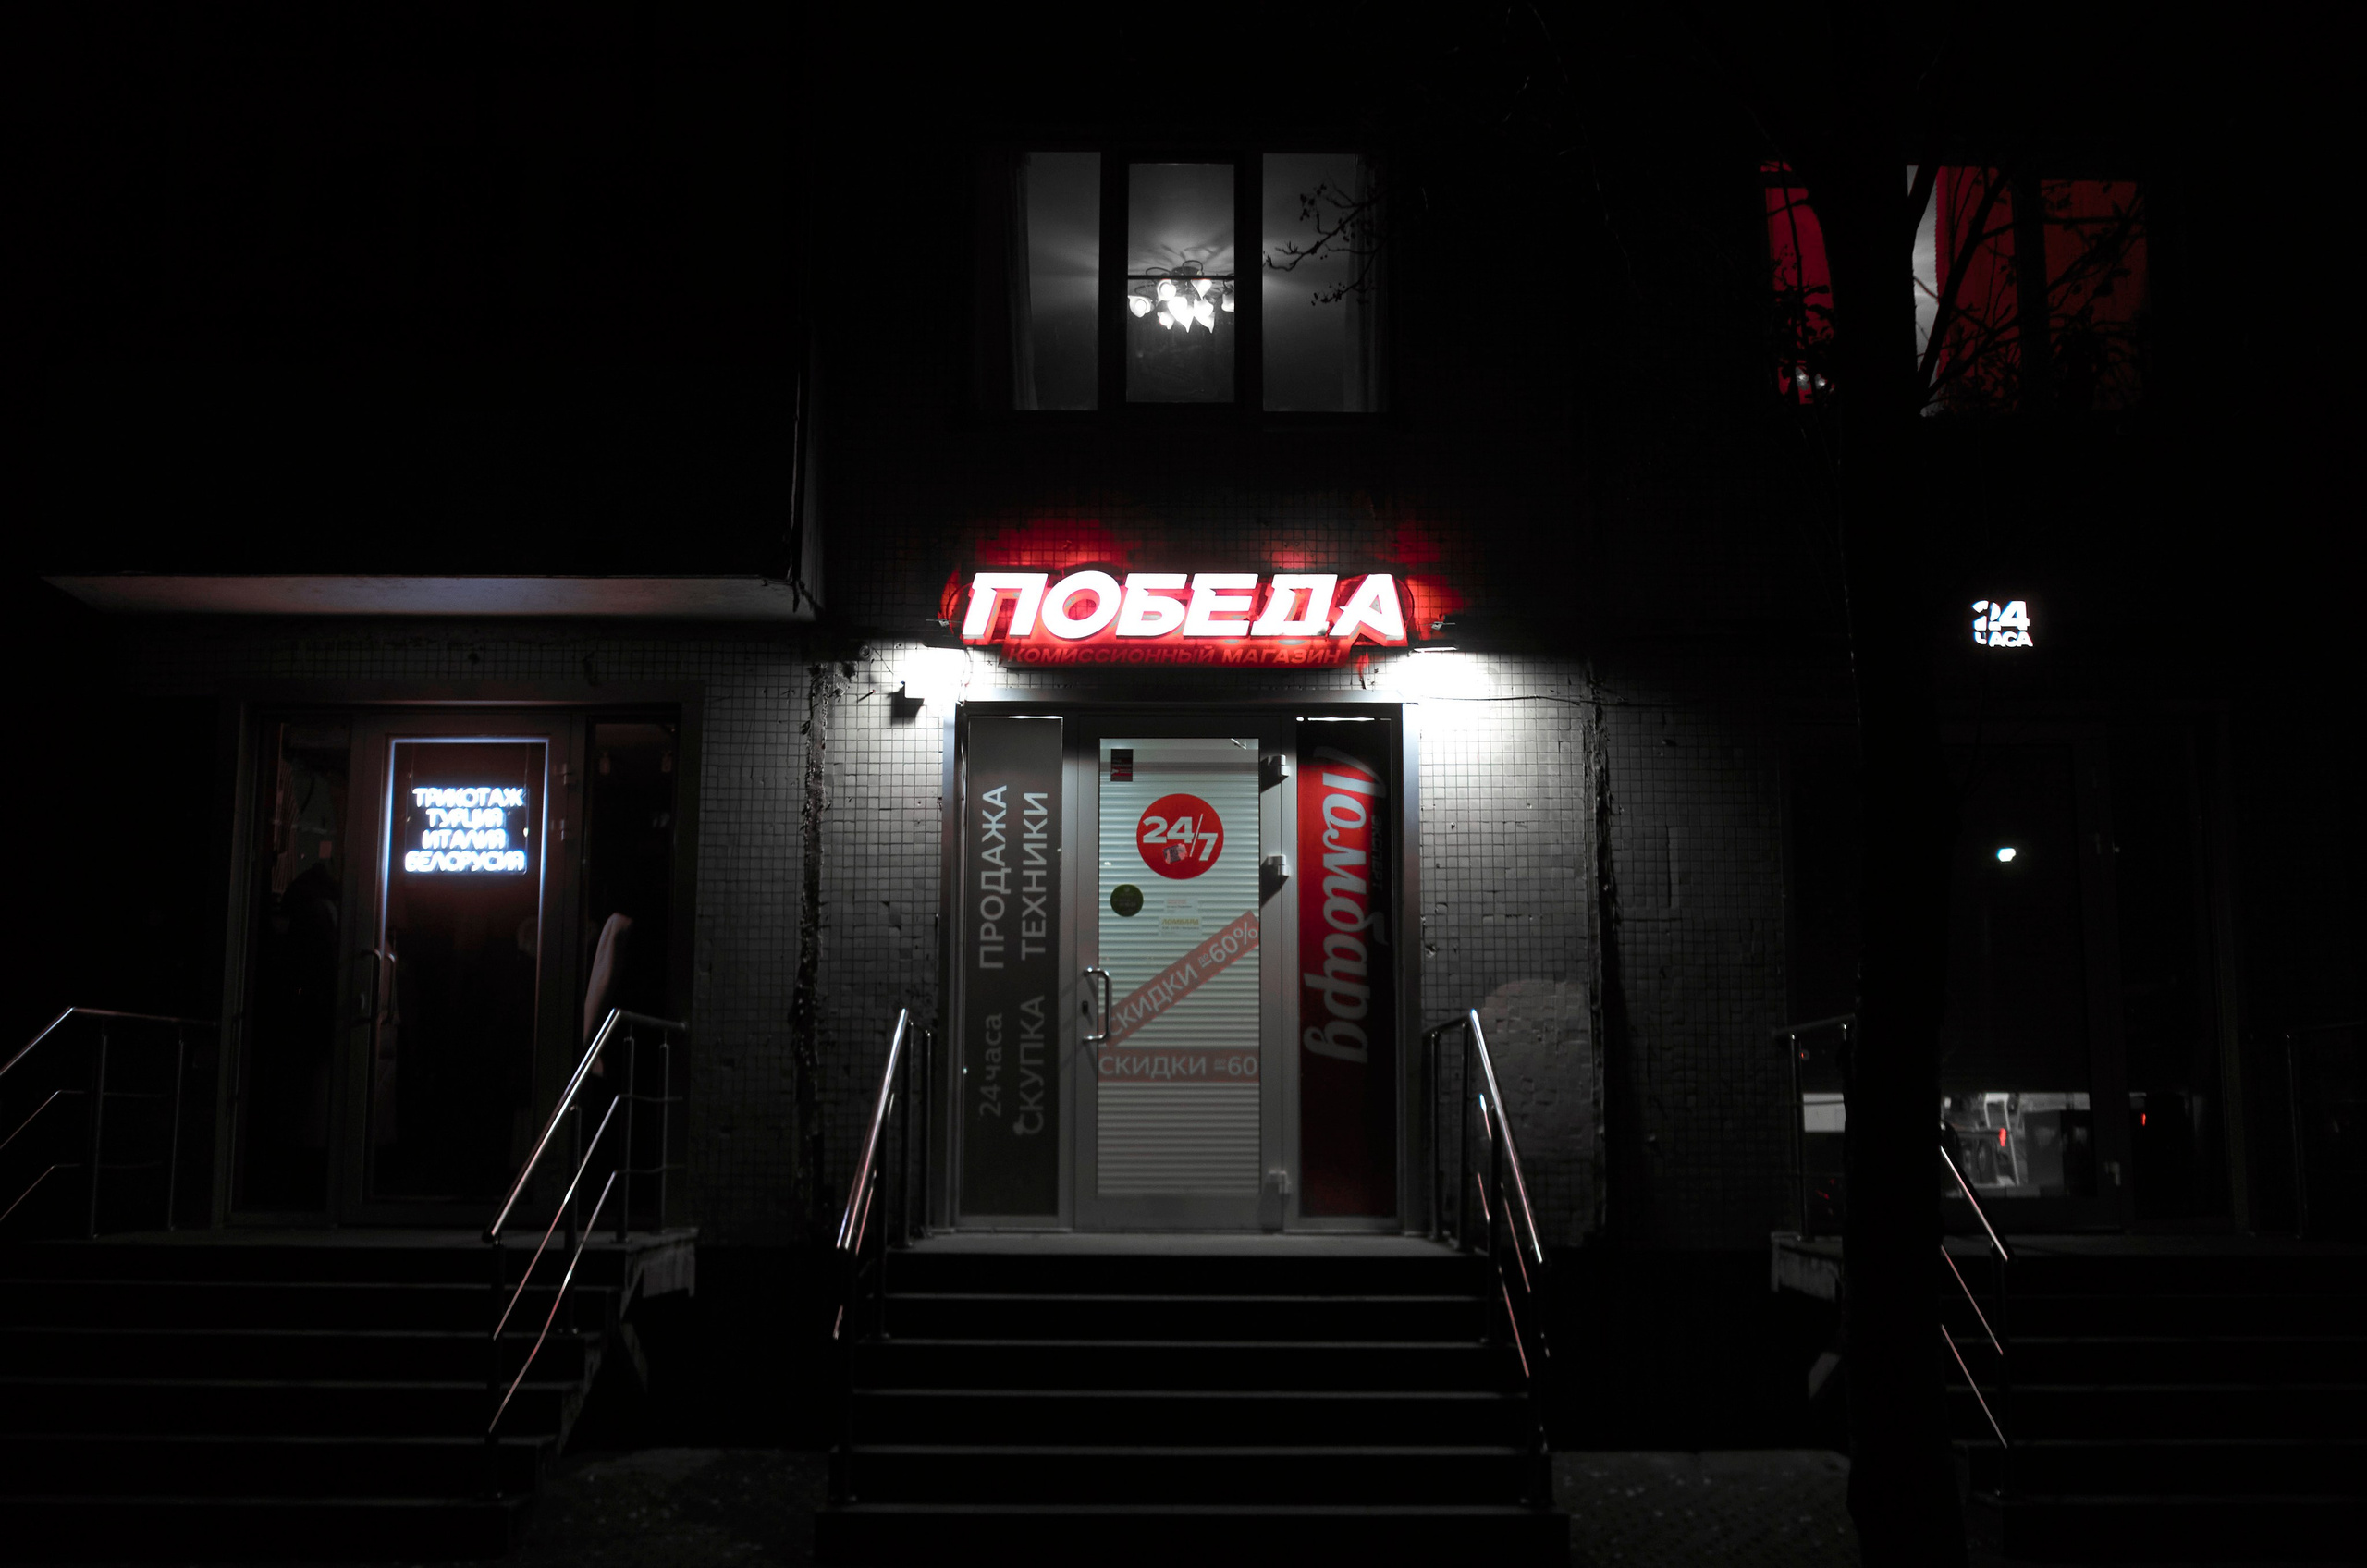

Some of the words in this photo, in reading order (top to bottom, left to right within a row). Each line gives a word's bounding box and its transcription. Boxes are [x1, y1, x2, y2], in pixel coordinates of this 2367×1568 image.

[963, 570, 1404, 640] ПОБЕДА
[1972, 600, 2030, 631] 24
[1008, 644, 1215, 664] КОМИССИОННЫЙ
[1221, 647, 1342, 664] МАГАЗИН
[412, 788, 524, 808] ТРИКОТАЖ
[426, 808, 504, 830] ТУРЦИЯ
[422, 829, 507, 850] ИТАЛИЯ
[1142, 813, 1219, 862] 24/7
[405, 851, 525, 872] БЕЛОРУСИЯ
[979, 785, 1011, 969] ПРОДАЖА
[1021, 792, 1048, 961] ТЕХНИКИ
[1304, 746, 1388, 1063] Ломбард
[1018, 994, 1046, 1136] СКУПКА
[1098, 1056, 1207, 1080] СКИДКИ
